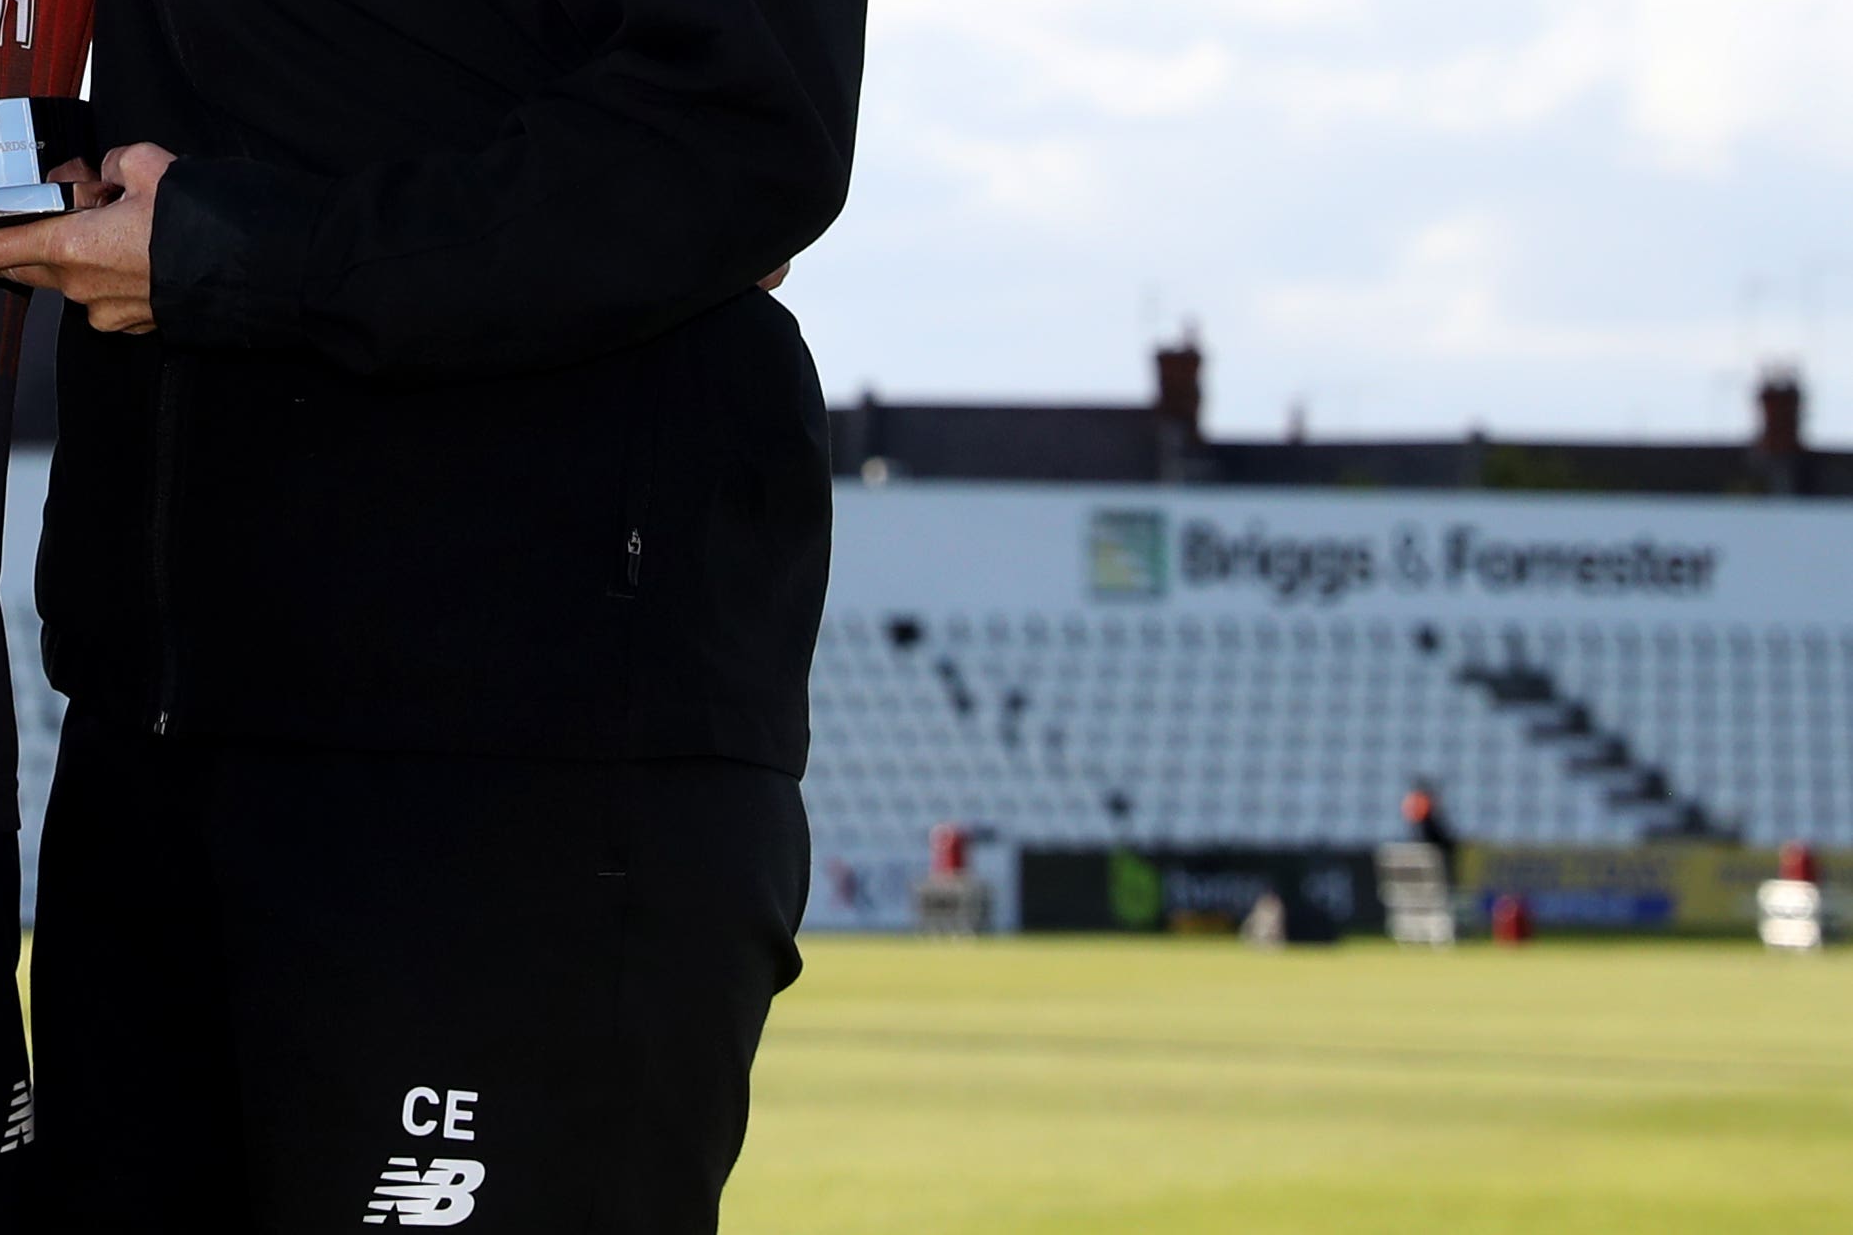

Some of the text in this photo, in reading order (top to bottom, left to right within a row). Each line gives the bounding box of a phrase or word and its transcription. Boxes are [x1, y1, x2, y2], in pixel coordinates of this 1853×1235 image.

[1180, 513, 1374, 609] Briggs
[1440, 521, 1723, 600] Forrester
[402, 1086, 479, 1141] CE
